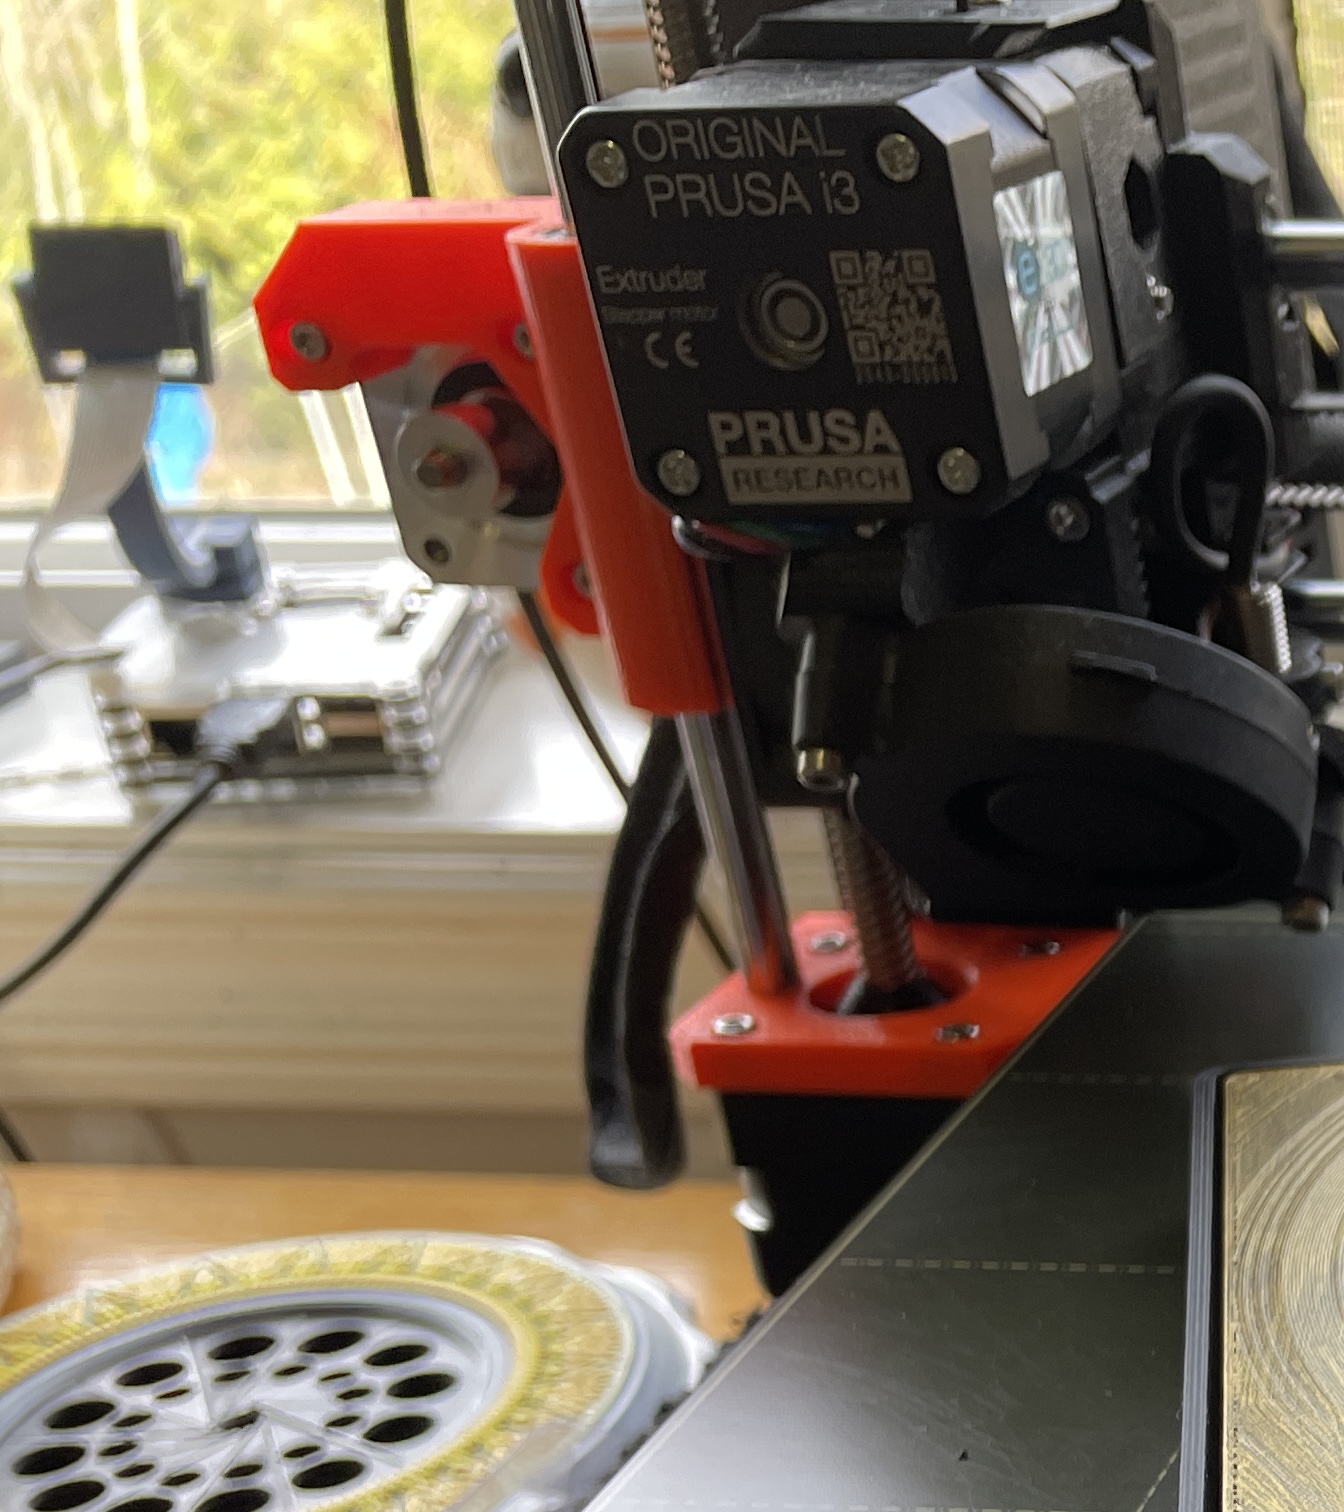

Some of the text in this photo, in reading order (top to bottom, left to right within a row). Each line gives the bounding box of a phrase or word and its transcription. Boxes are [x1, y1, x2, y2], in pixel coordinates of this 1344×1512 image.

[632, 115, 848, 163] ORIGINAL
[644, 170, 860, 218] PRUSA i3
[595, 263, 708, 294] Extruder
[707, 407, 903, 455] PRUSA
[731, 466, 901, 493] RESEARCH
